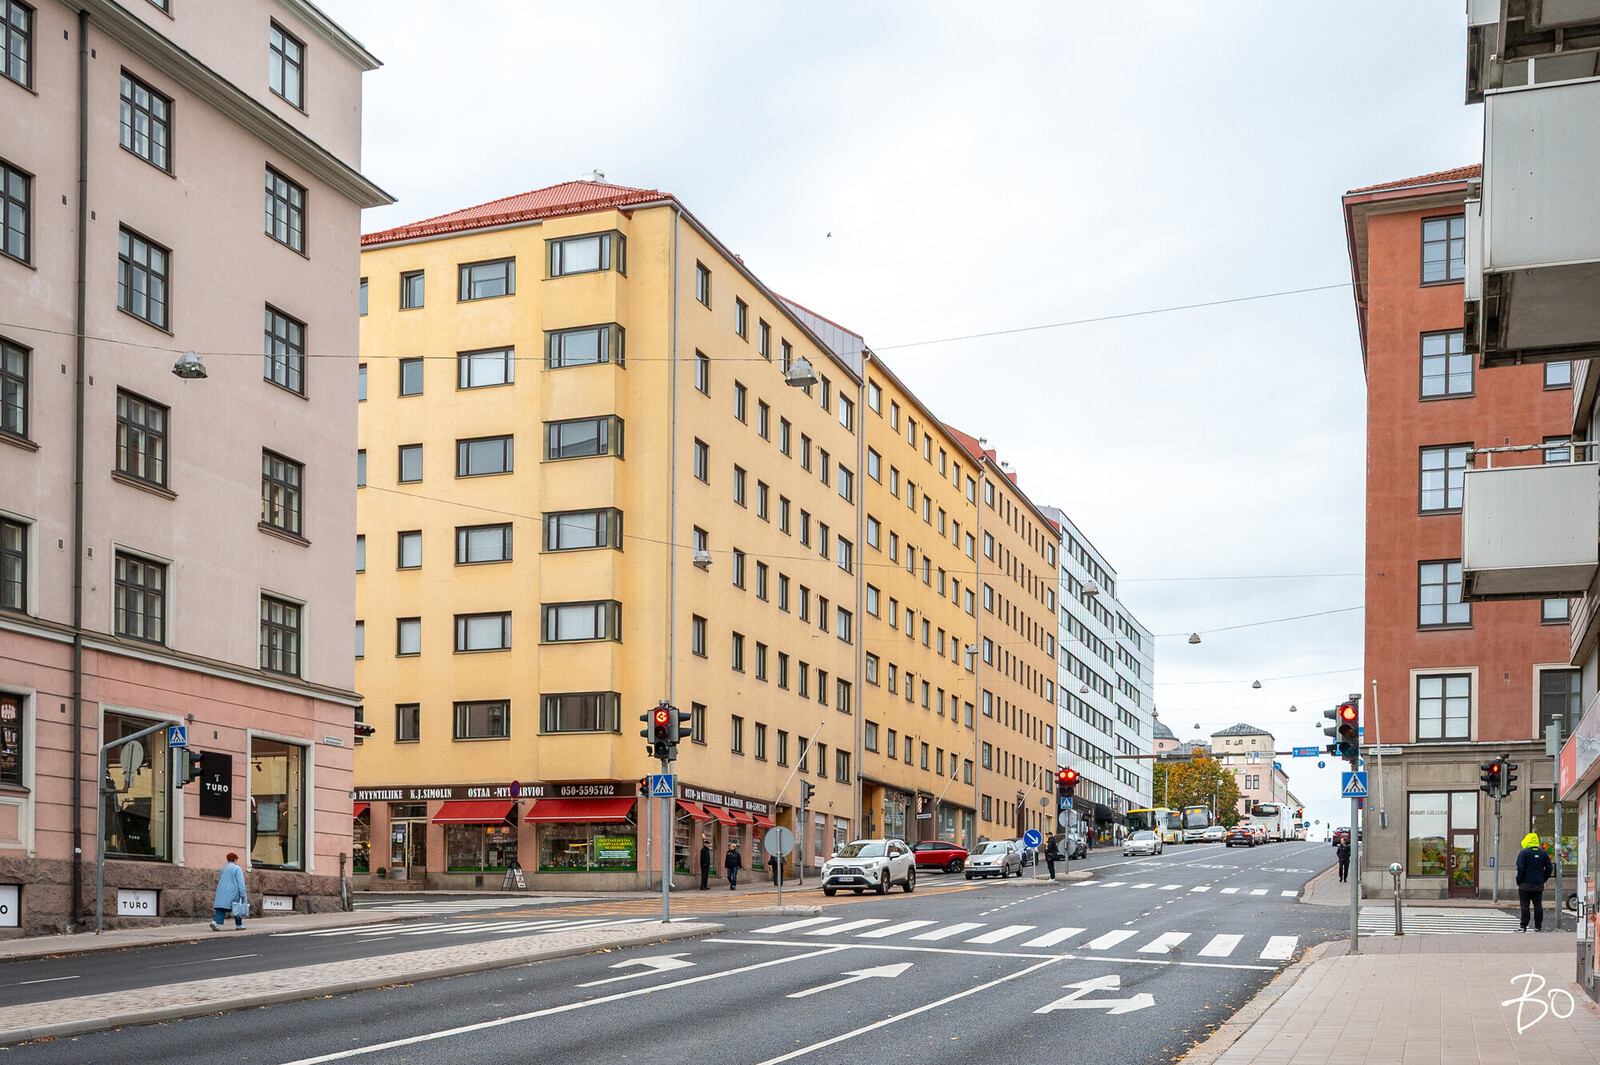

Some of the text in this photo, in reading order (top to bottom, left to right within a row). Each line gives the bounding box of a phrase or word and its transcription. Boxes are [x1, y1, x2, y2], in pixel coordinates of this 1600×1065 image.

[206, 782, 229, 792] TURO
[358, 790, 403, 800] MYYNTILIIKE
[410, 788, 452, 800] K.J.SIMOLIN
[467, 788, 491, 798] OSTAA
[560, 785, 614, 796] 050-5595702
[122, 901, 148, 910] TURO
